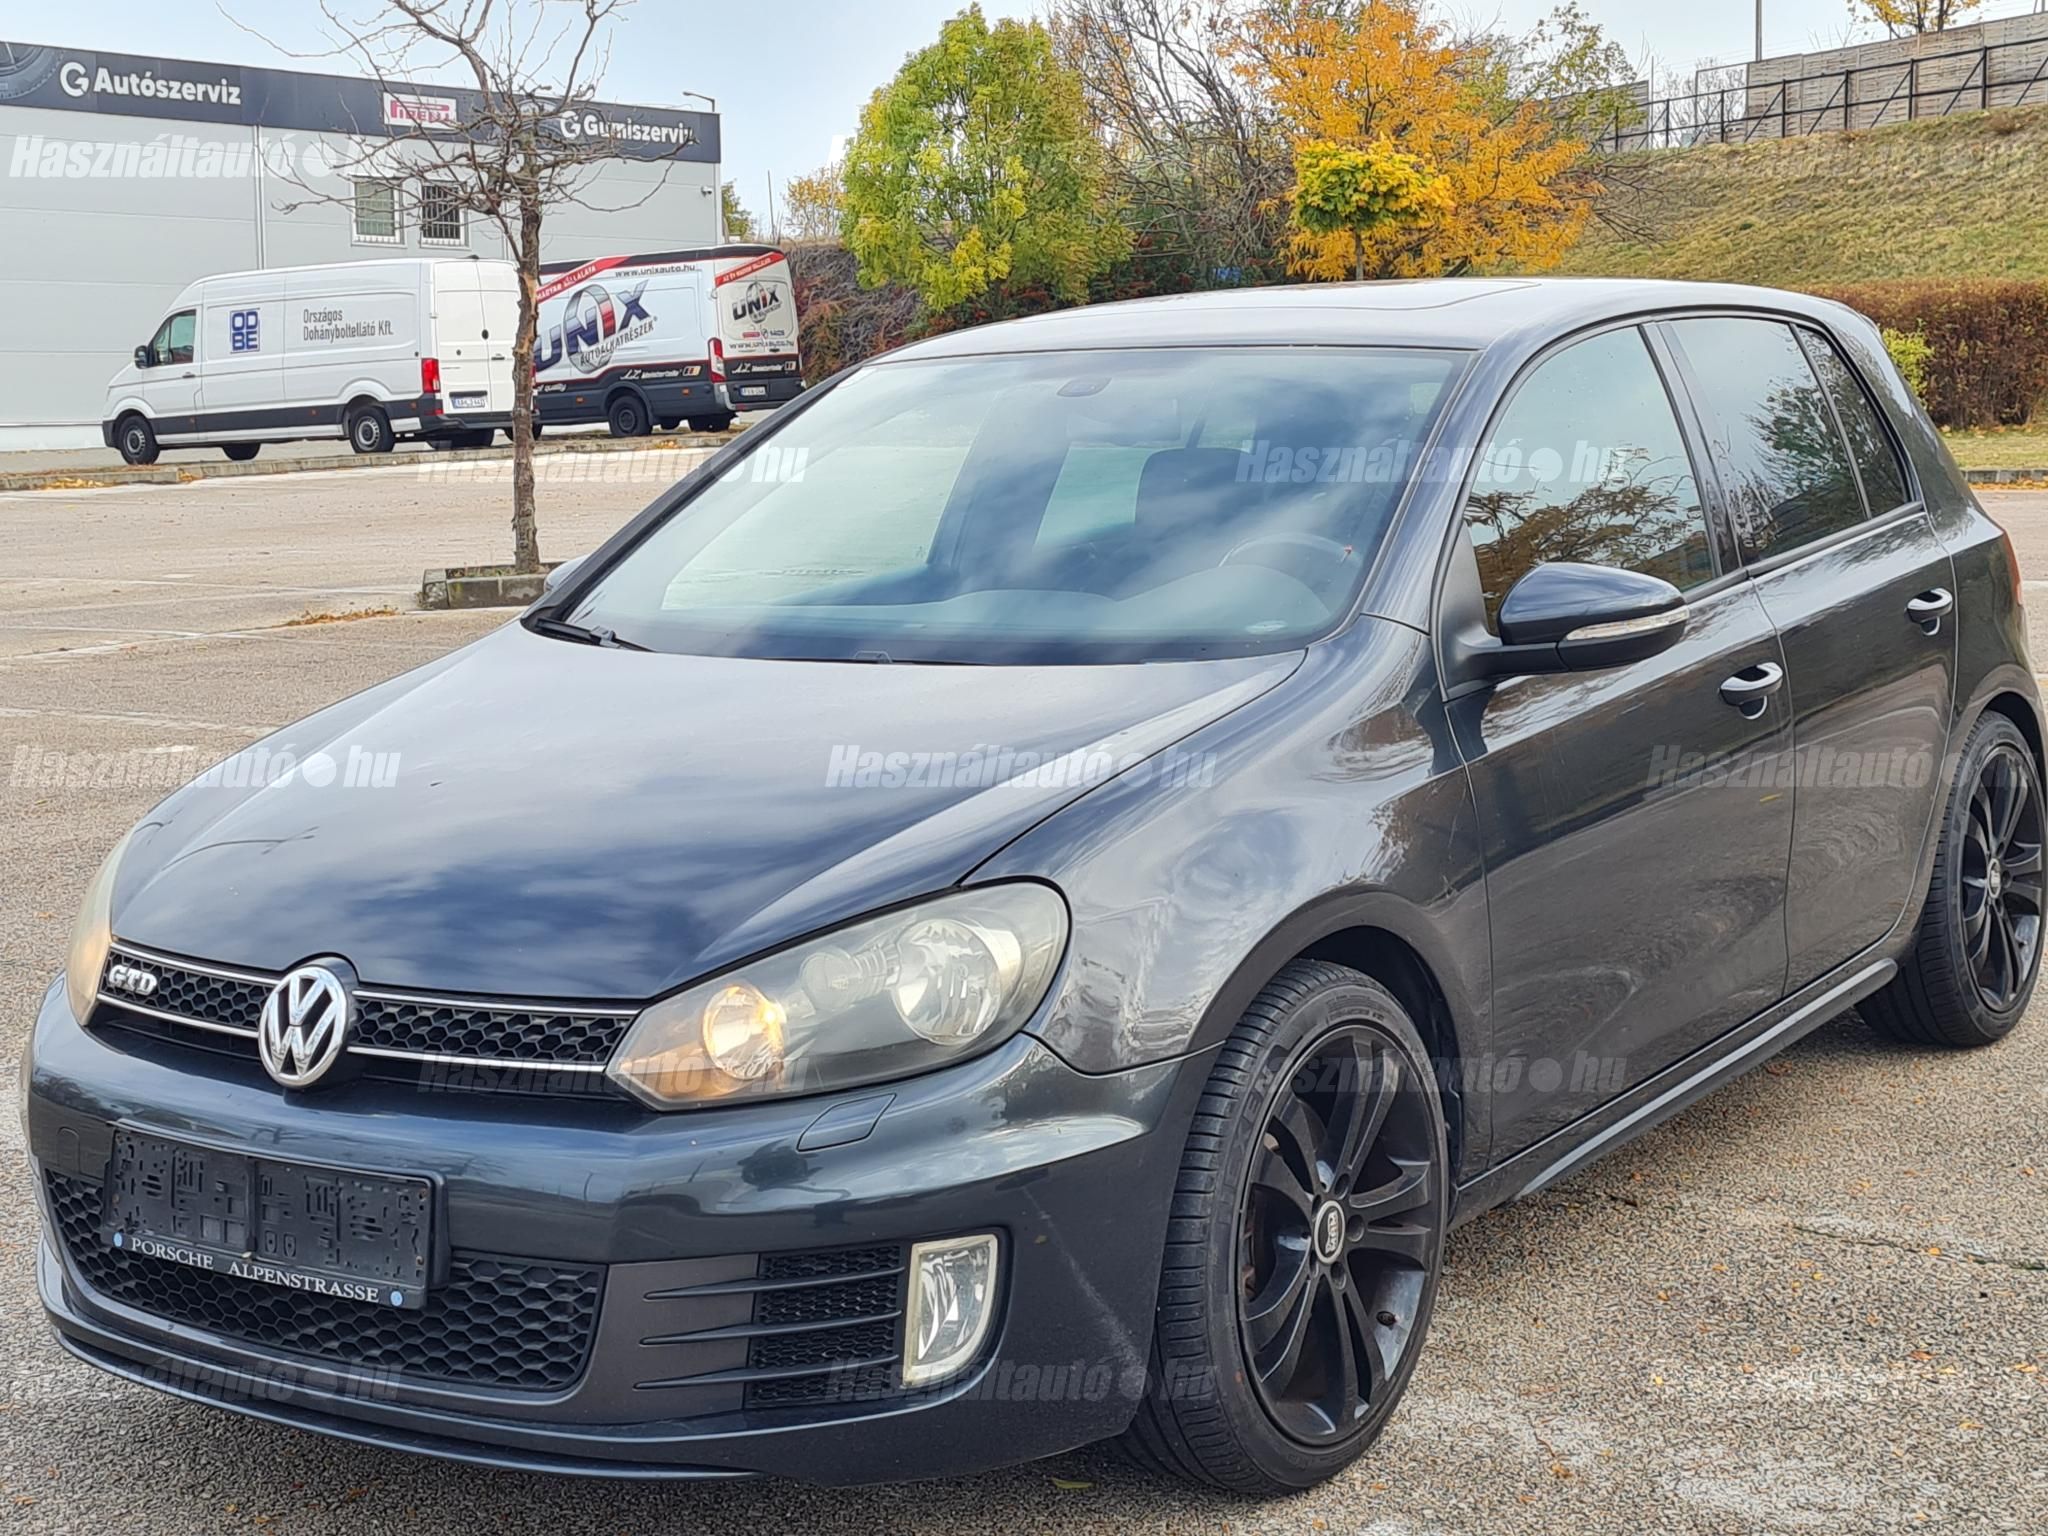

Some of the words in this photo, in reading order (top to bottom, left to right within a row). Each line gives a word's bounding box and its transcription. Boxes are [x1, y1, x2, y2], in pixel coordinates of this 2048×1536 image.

[94, 67, 241, 105] Autószerviz
[303, 307, 343, 325] Országos
[732, 284, 780, 321] UNIX
[303, 322, 376, 343] Dohányboltellátó
[108, 964, 158, 996] GTD
[131, 1237, 214, 1269] PORSCHE
[227, 1261, 380, 1303] ALPENSTRASSE
